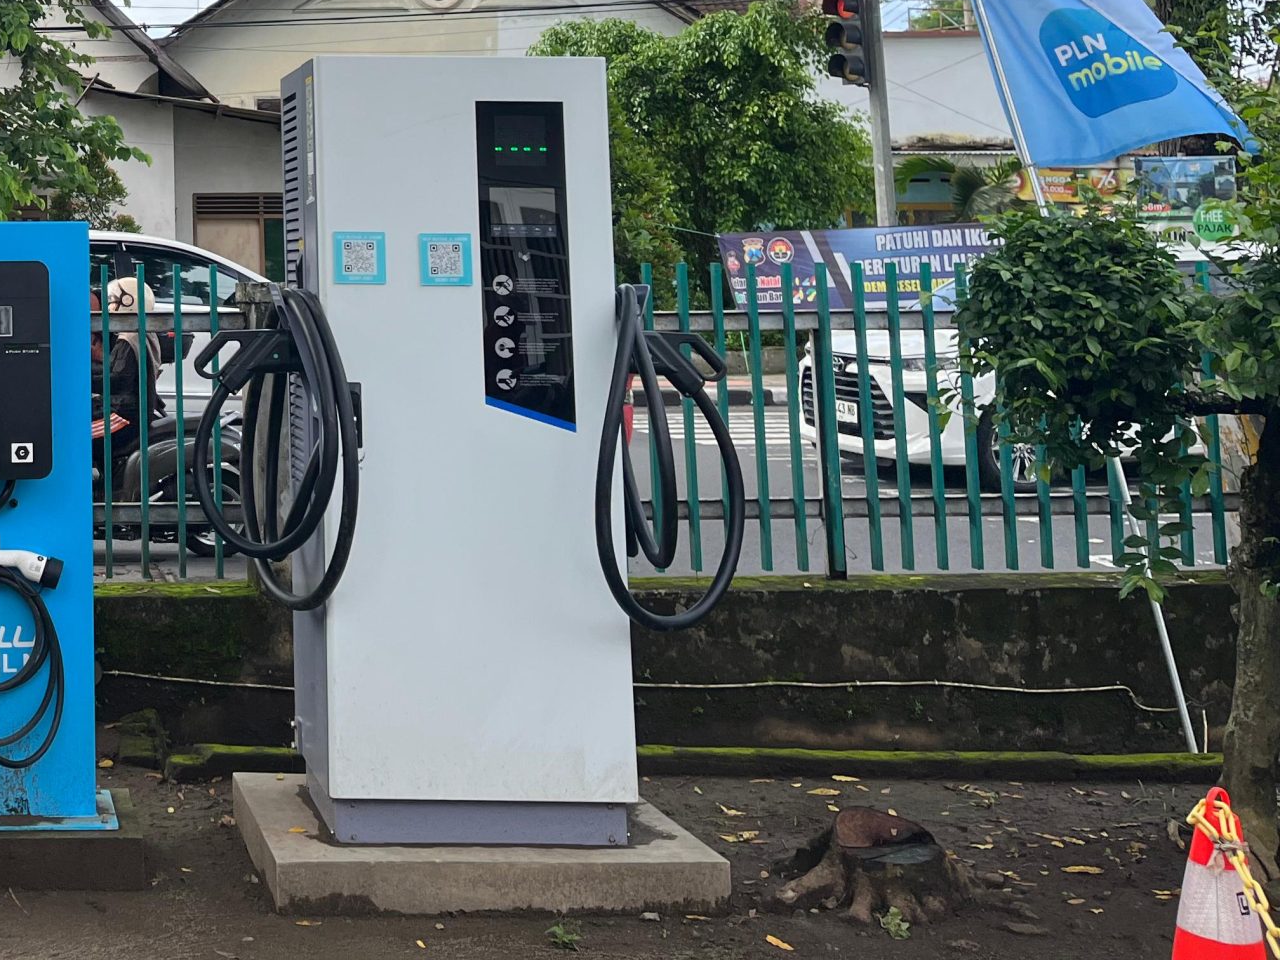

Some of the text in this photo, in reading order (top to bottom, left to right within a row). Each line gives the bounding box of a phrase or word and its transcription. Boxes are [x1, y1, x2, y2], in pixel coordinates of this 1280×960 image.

[1054, 33, 1107, 67] PLN
[1068, 50, 1163, 91] mobile
[1200, 210, 1223, 223] FREE
[1197, 223, 1233, 233] PAJAK
[876, 230, 929, 251] PATUHI
[931, 228, 962, 248] DAN
[863, 281, 887, 293] DEM
